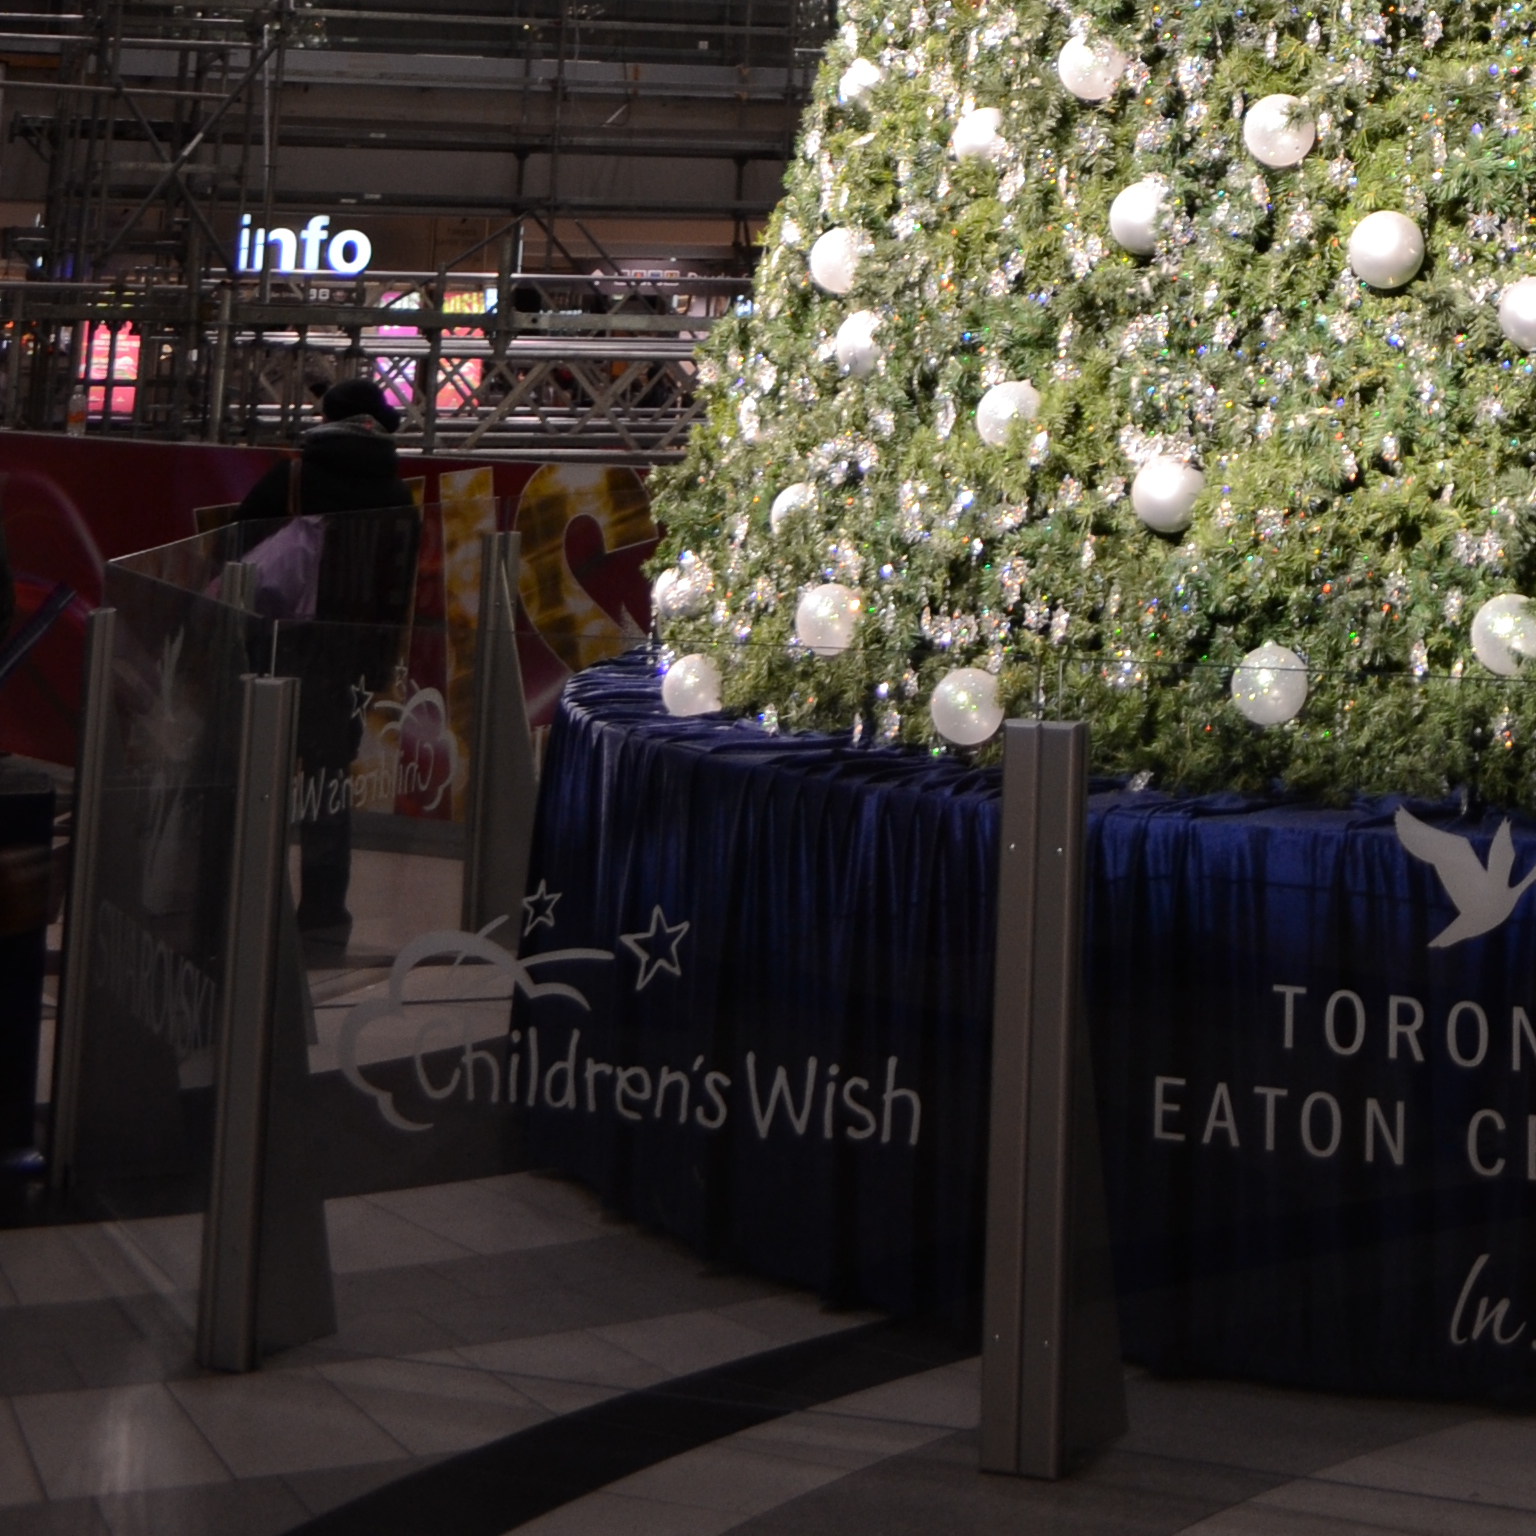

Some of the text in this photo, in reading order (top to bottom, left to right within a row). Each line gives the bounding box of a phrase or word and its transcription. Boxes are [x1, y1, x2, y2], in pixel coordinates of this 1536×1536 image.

[237, 213, 372, 273] info
[415, 1021, 922, 1146] Children's Wish
[1152, 1074, 1405, 1167] EATON
